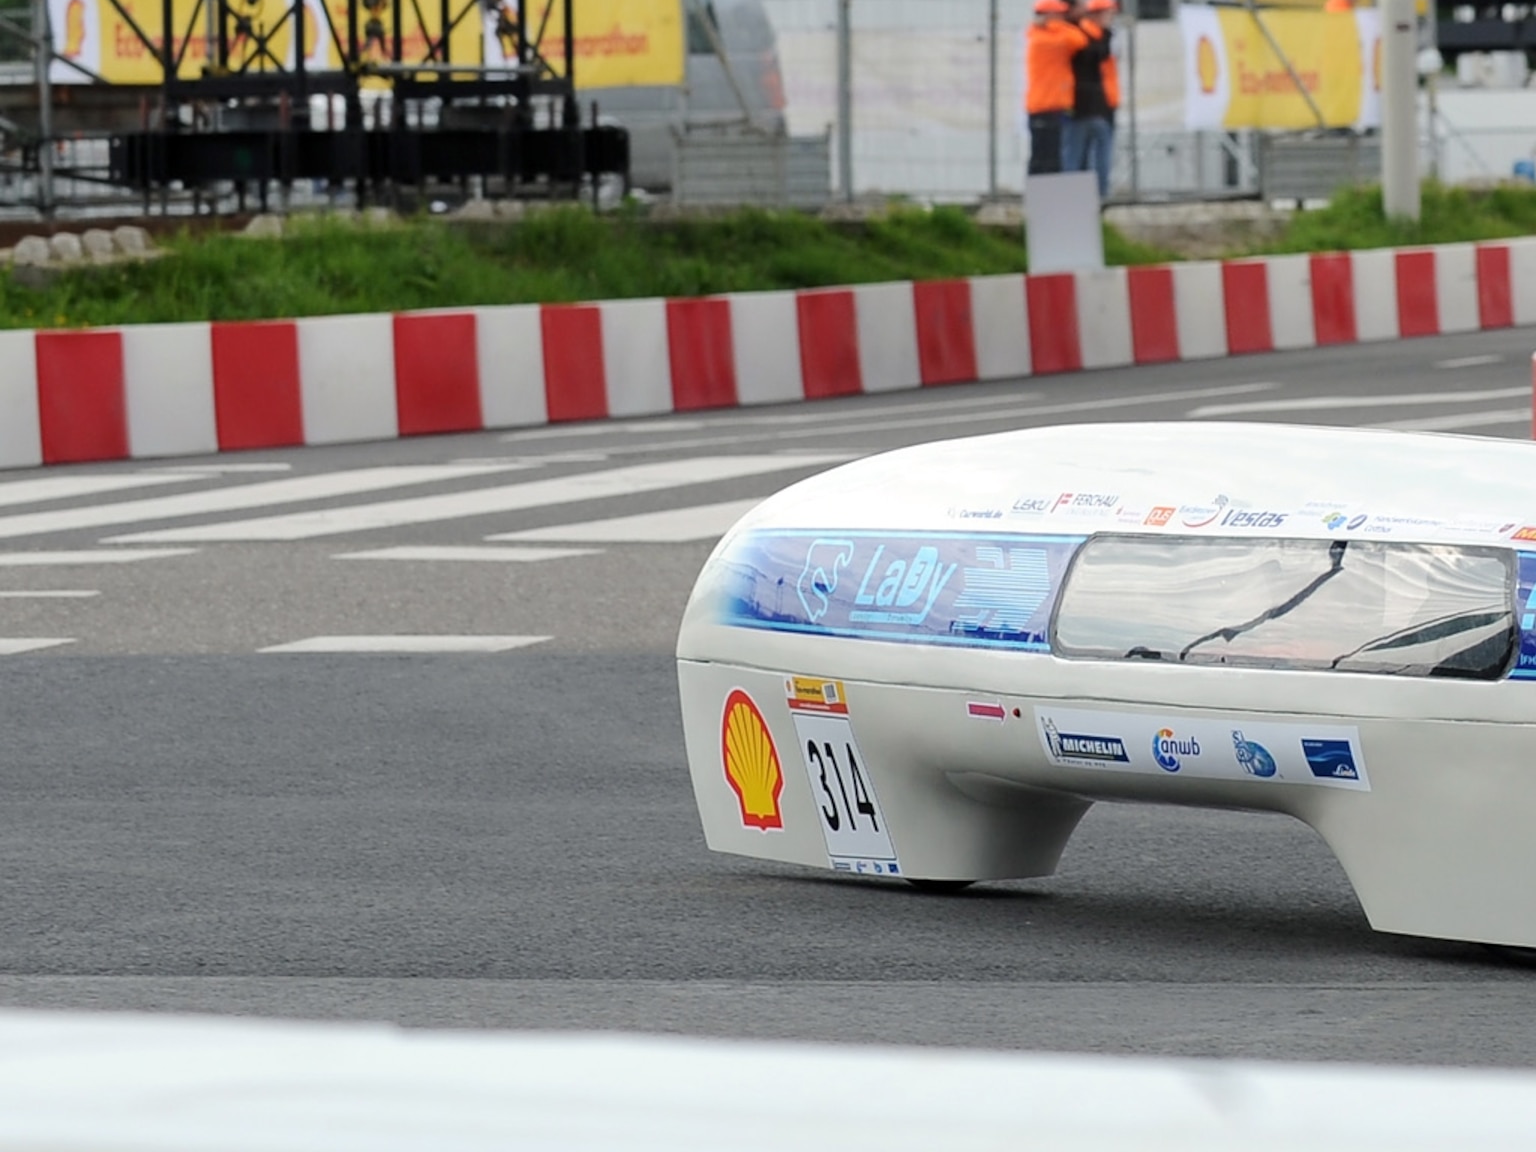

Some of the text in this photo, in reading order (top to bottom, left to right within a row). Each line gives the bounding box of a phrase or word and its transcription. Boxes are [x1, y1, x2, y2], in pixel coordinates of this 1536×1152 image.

[1220, 509, 1287, 528] Vestas
[1062, 738, 1124, 756] MICHELIN
[1161, 736, 1200, 756] anwb
[807, 739, 879, 832] 314
